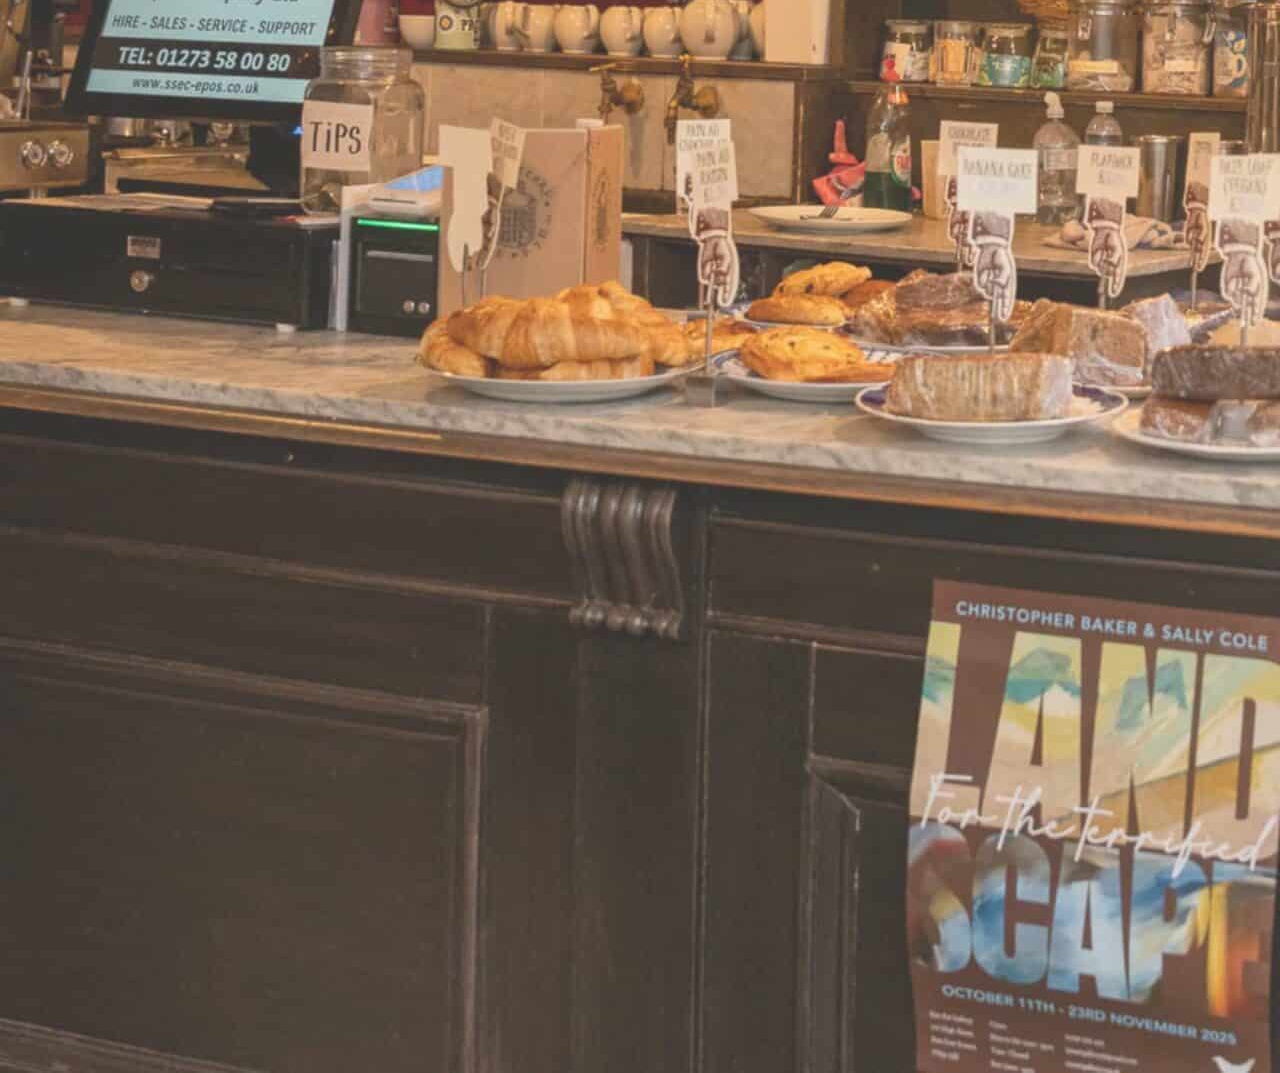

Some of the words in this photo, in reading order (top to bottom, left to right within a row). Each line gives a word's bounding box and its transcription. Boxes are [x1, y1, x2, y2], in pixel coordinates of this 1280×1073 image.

[112, 15, 139, 28] HIRE
[150, 16, 187, 31] SALES
[197, 18, 248, 33] SERVICE
[257, 20, 317, 36] SUPPORT
[119, 46, 152, 65] TEL:
[156, 48, 211, 68] 01273
[213, 51, 236, 70] 58
[240, 53, 265, 71] 00
[266, 54, 291, 72] 80
[131, 77, 260, 95] www.ssec-epos.co.uk
[956, 600, 1075, 630] CHRISTOPHER
[1080, 616, 1138, 637] BAKER
[1143, 623, 1156, 639] &
[1161, 624, 1214, 645] SALLY
[1219, 631, 1269, 652] COLE
[920, 773, 998, 829] For
[995, 784, 1076, 852] the
[1071, 795, 1280, 879] terrified
[941, 983, 1015, 1008] OCTOBER
[1019, 996, 1056, 1014] 11TH
[1068, 1006, 1107, 1023] 23RD
[1110, 1013, 1198, 1040] NOVEMBER
[1201, 1028, 1238, 1047] 2025
